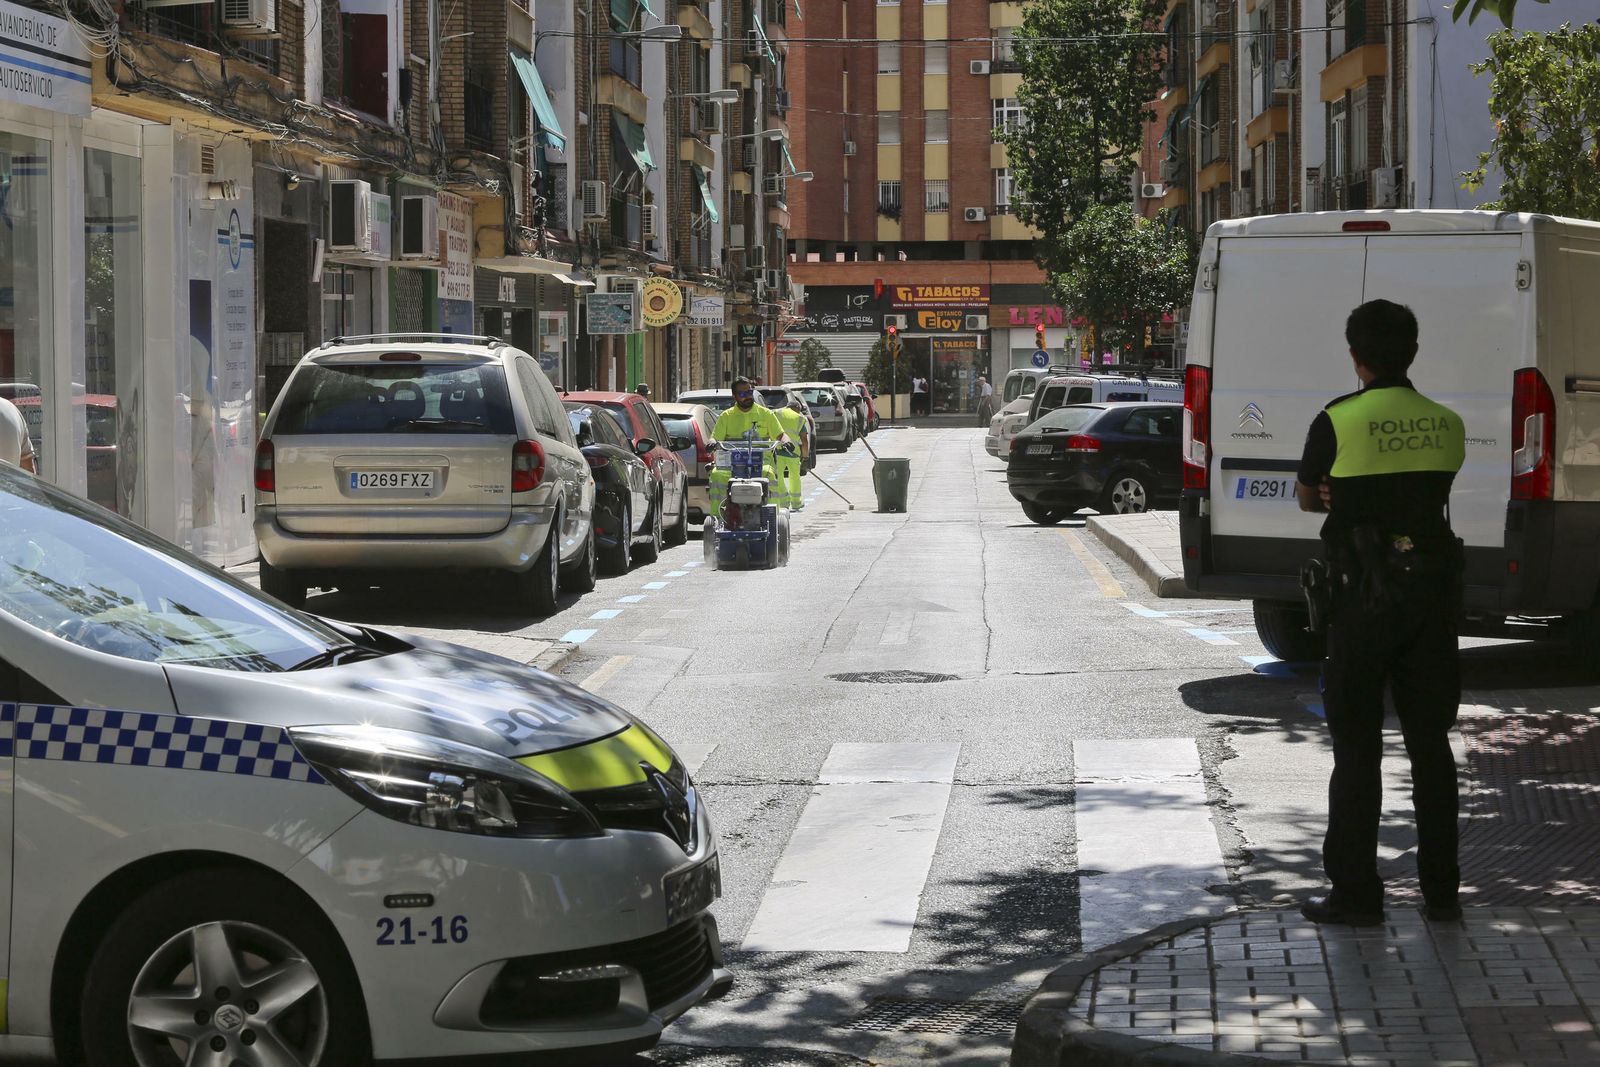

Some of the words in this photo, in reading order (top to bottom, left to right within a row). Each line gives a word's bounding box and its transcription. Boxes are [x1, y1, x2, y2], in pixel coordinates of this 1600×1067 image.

[47, 26, 57, 47] DE
[0, 67, 53, 98] AUTOSERVICIO
[916, 286, 980, 297] TABACOS
[700, 317, 710, 325] 161
[711, 317, 723, 325] 911
[925, 316, 962, 332] Eloy
[1008, 304, 1064, 326] LEN
[1368, 417, 1450, 436] POLICIA
[1378, 434, 1445, 453] LOCAL
[1250, 480, 1287, 498] 6291
[376, 914, 469, 946] 21-16
